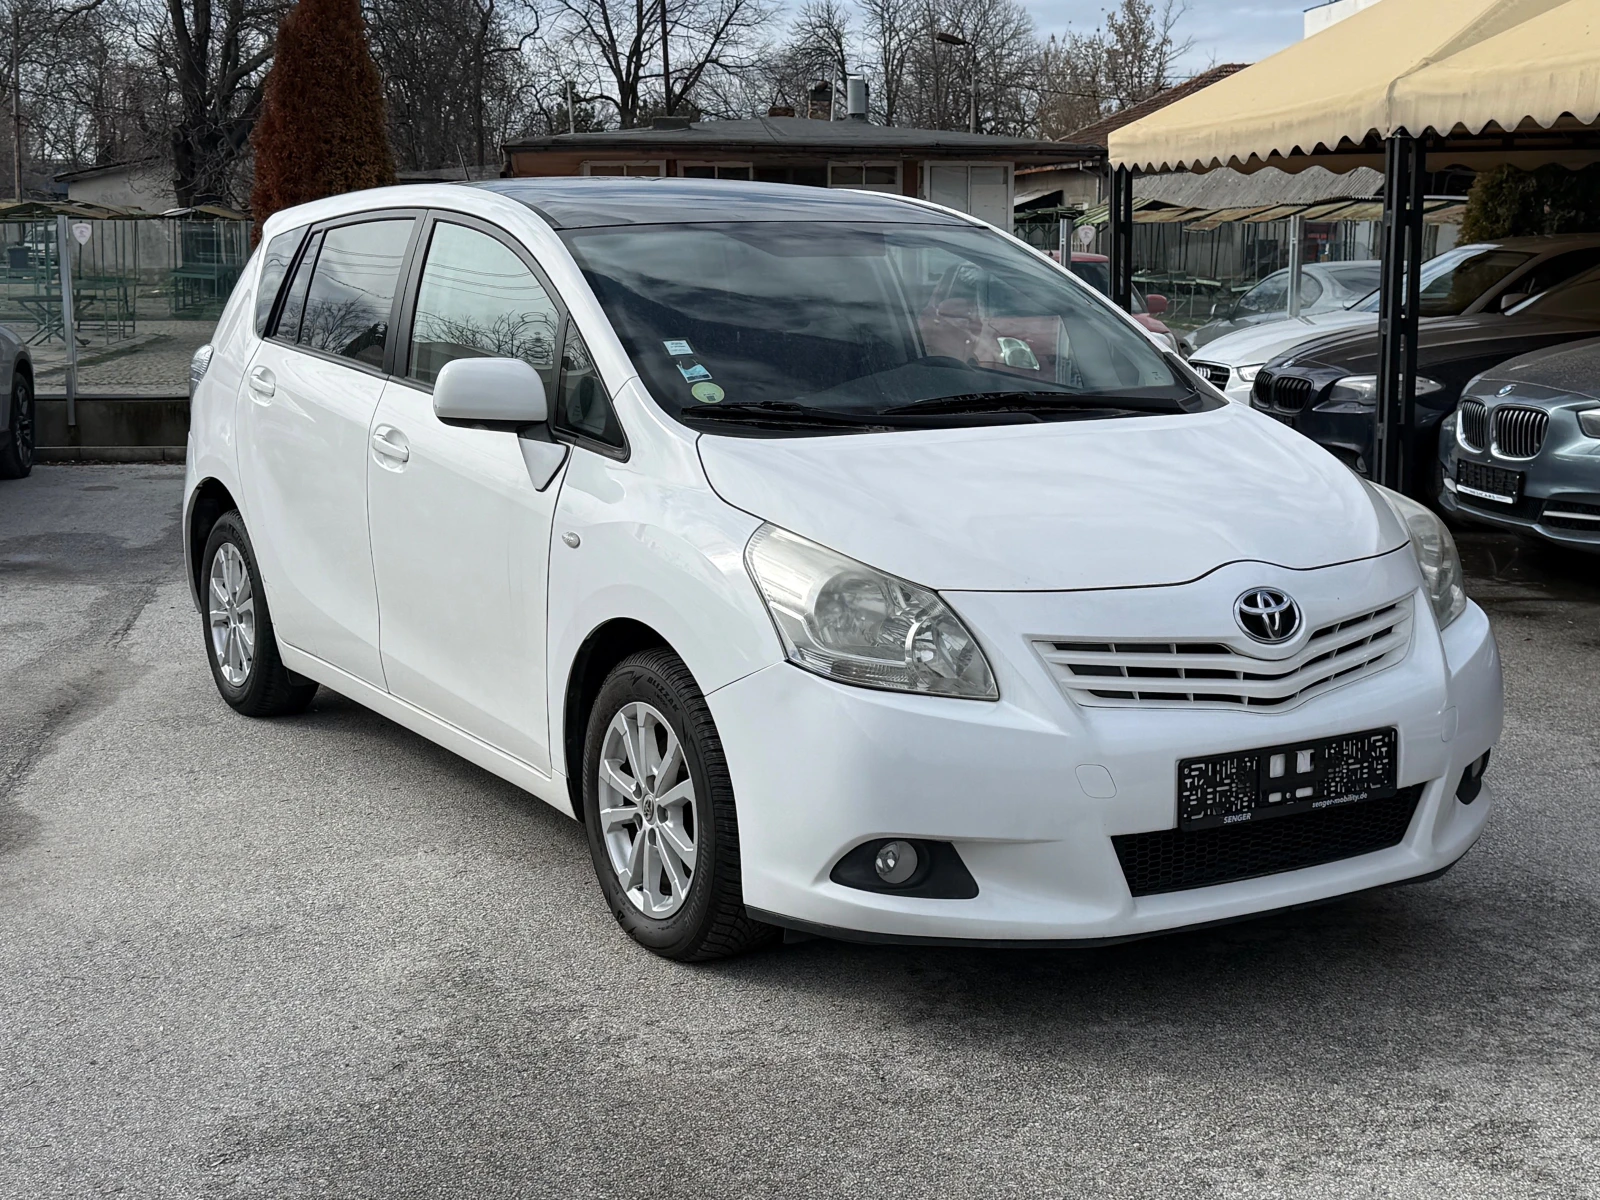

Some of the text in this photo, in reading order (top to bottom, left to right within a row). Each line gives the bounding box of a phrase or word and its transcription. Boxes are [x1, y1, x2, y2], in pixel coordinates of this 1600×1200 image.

[646, 676, 680, 712] BLIZZAK
[1311, 791, 1368, 808] senger-mobility.de
[1223, 812, 1252, 824] SENGER
